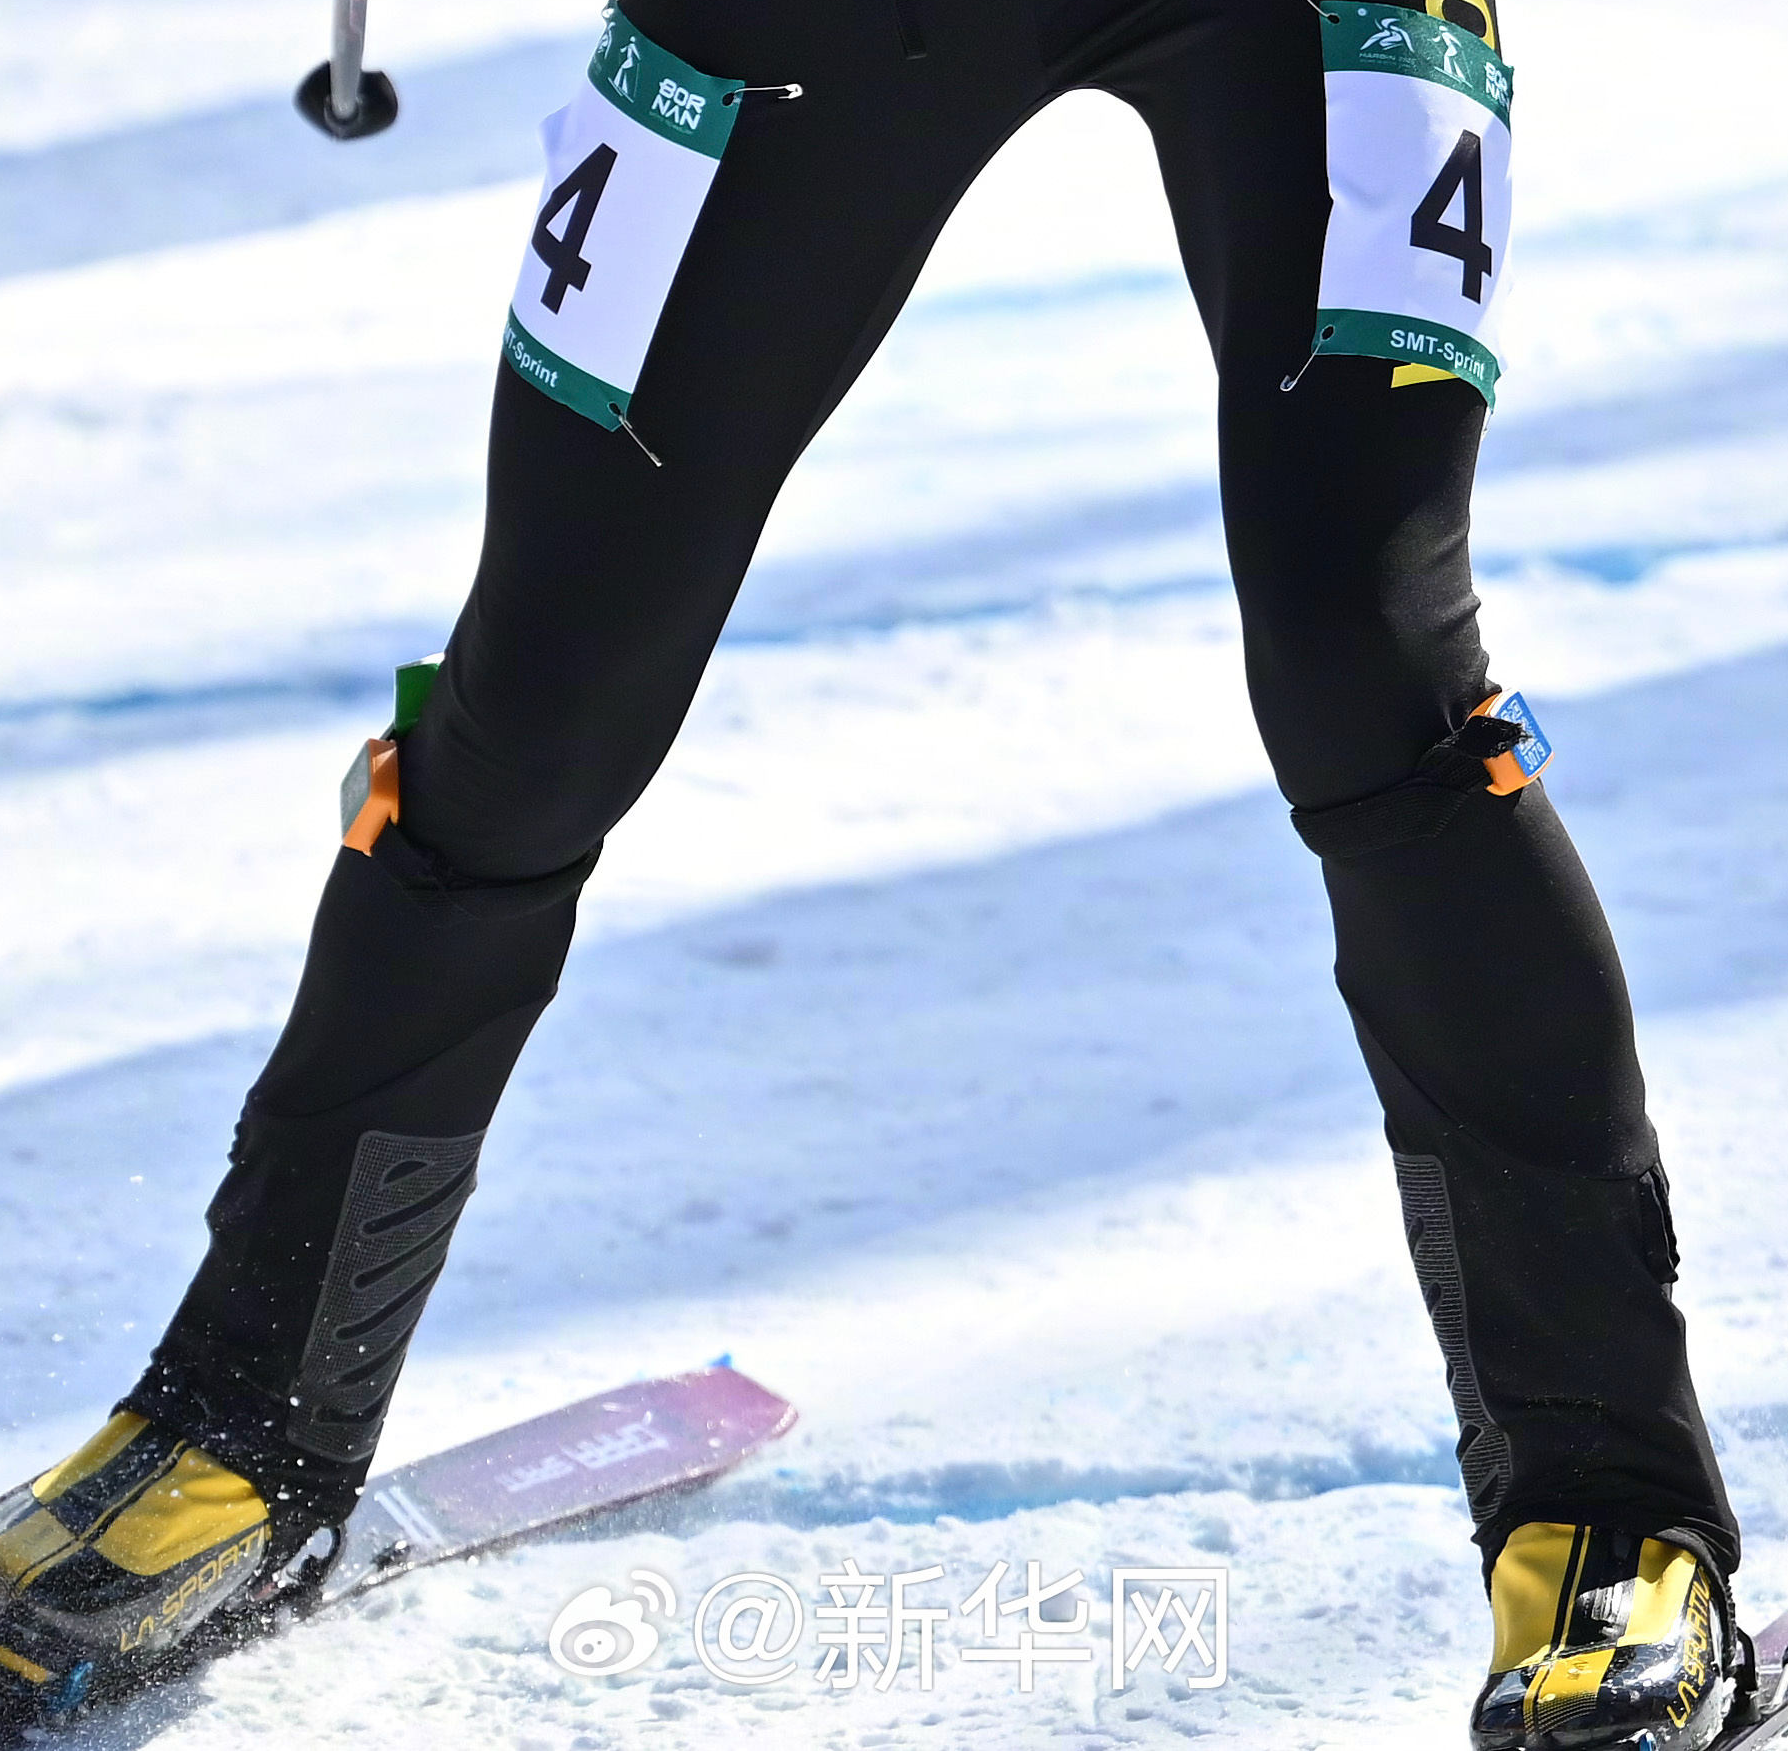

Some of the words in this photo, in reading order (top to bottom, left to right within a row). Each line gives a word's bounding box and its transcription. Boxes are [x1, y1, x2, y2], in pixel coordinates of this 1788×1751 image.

[651, 94, 701, 130] NAN
[659, 78, 706, 114] BOR
[531, 142, 619, 315] 4
[1410, 129, 1492, 305] 4
[1390, 329, 1486, 381] SMT-Sprint
[1523, 741, 1547, 771] 3079
[120, 1615, 155, 1653] LA
[1666, 1680, 1699, 1729] LA
